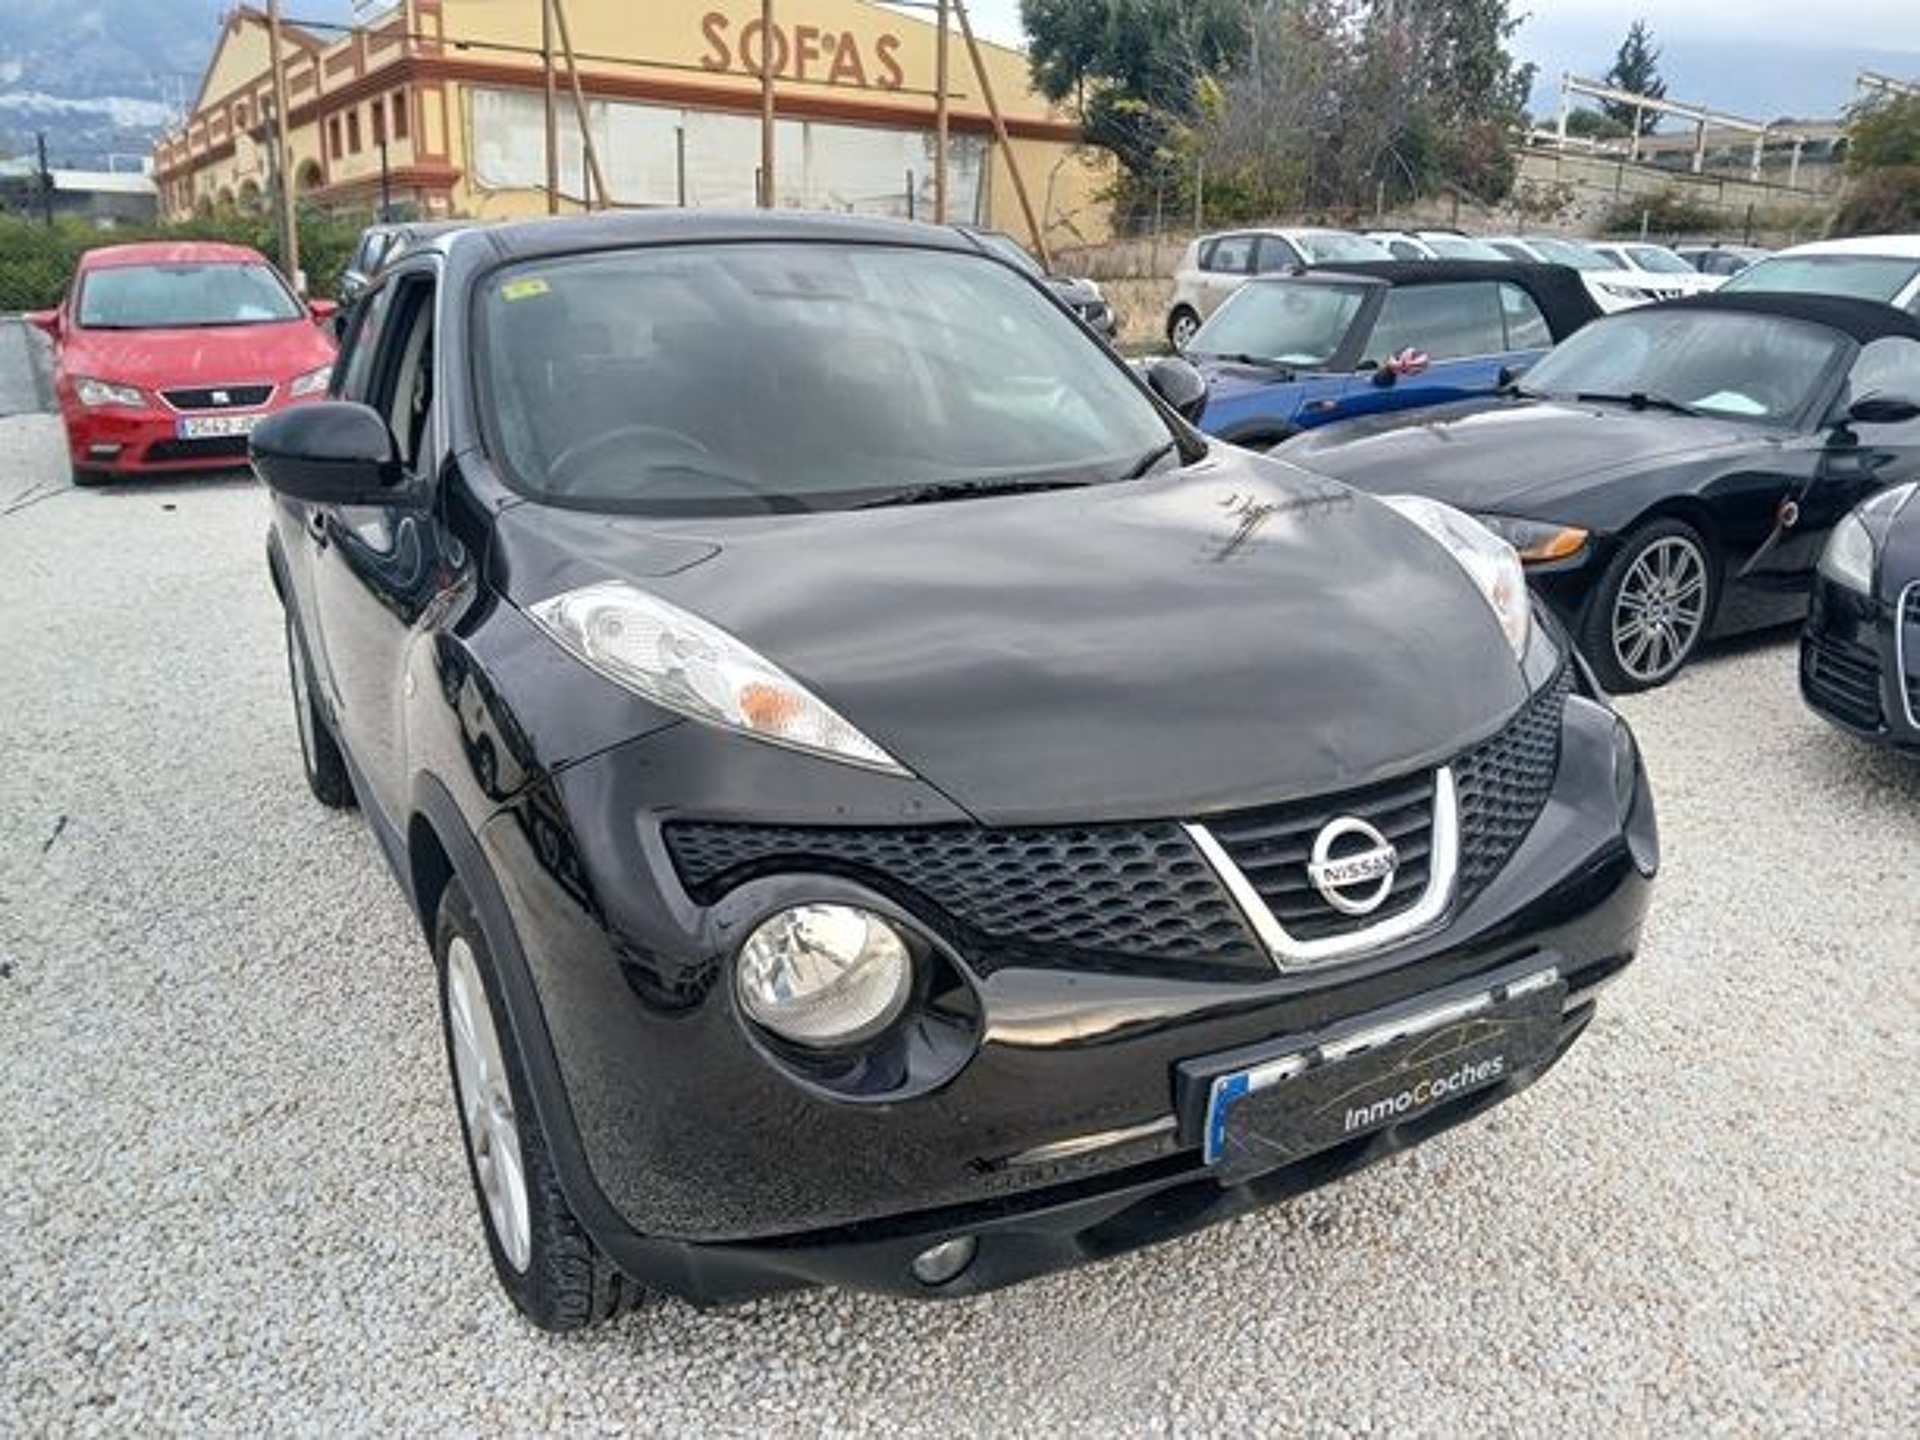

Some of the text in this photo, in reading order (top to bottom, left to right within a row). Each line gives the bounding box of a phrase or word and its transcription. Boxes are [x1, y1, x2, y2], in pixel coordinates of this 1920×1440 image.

[701, 11, 904, 90] SOFAS
[1323, 851, 1394, 881] NISSAN
[1345, 1055, 1503, 1130] InmoCoches
